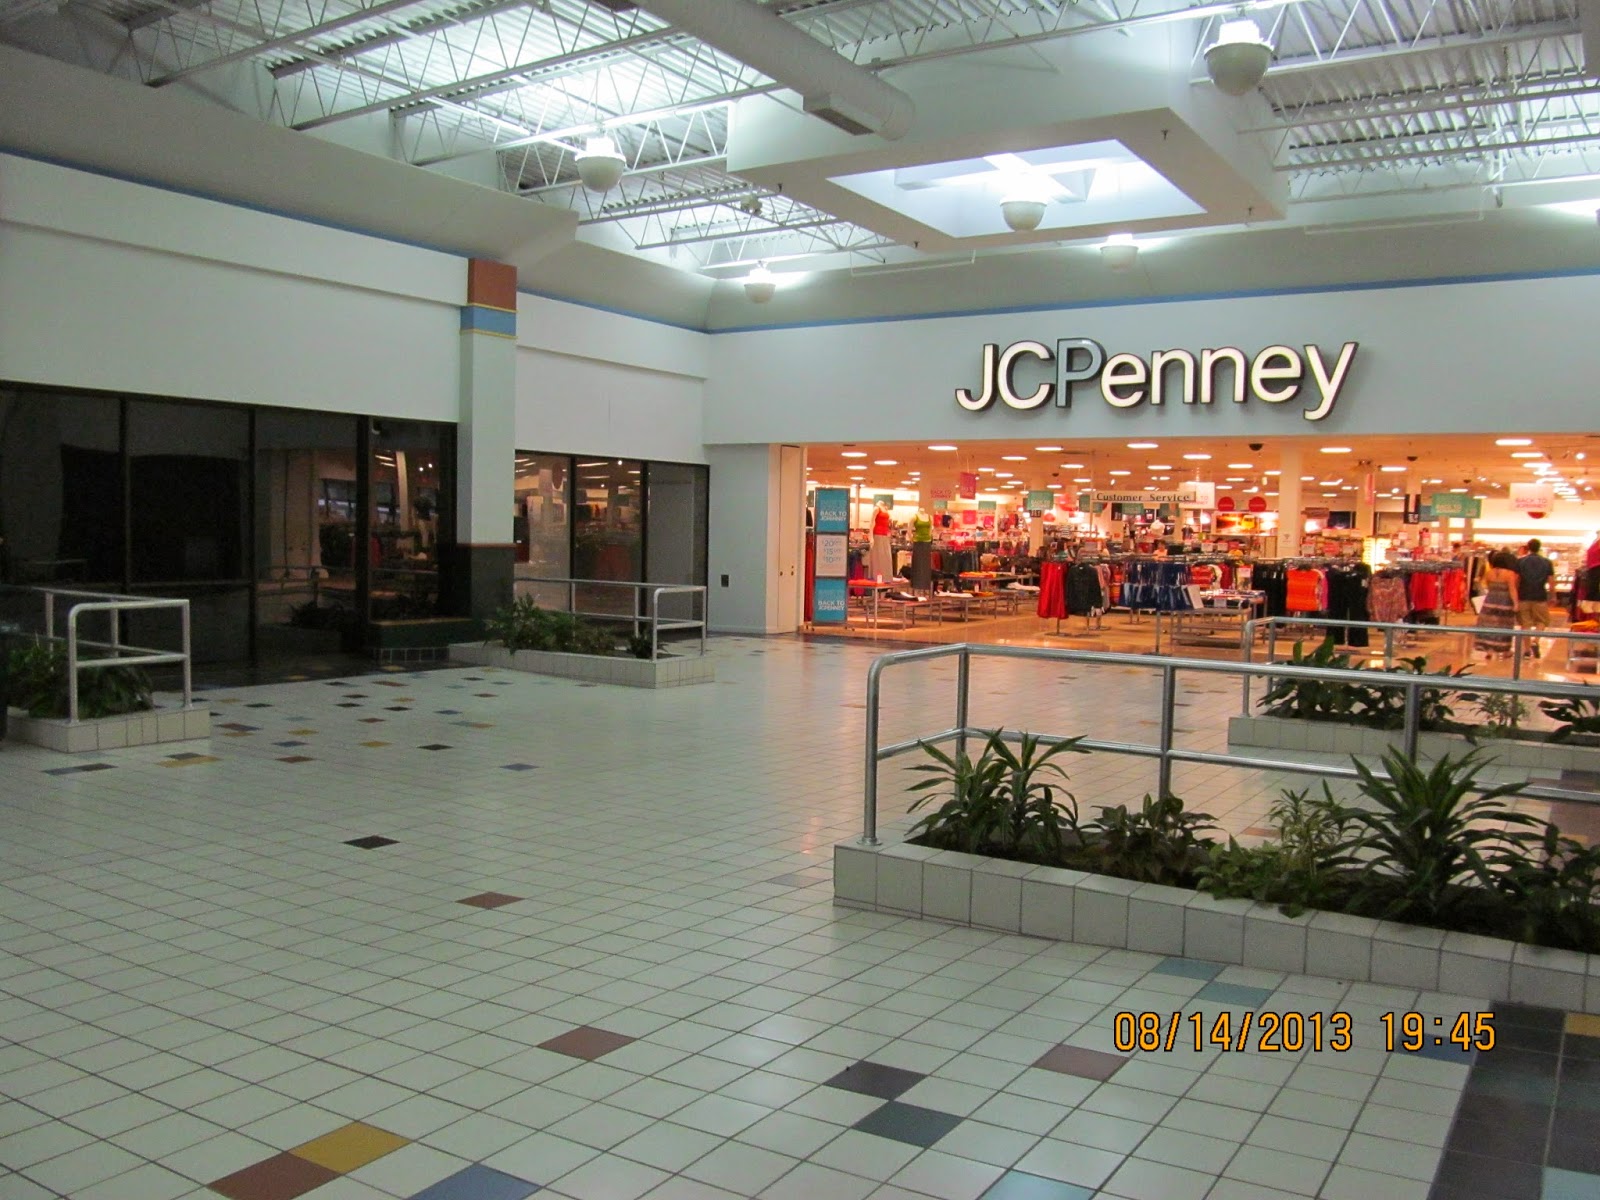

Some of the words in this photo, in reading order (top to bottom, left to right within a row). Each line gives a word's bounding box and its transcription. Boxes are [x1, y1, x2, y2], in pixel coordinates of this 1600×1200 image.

[955, 337, 1359, 421] JCPenney
[1096, 492, 1143, 502] Customer
[1149, 492, 1190, 502] Service
